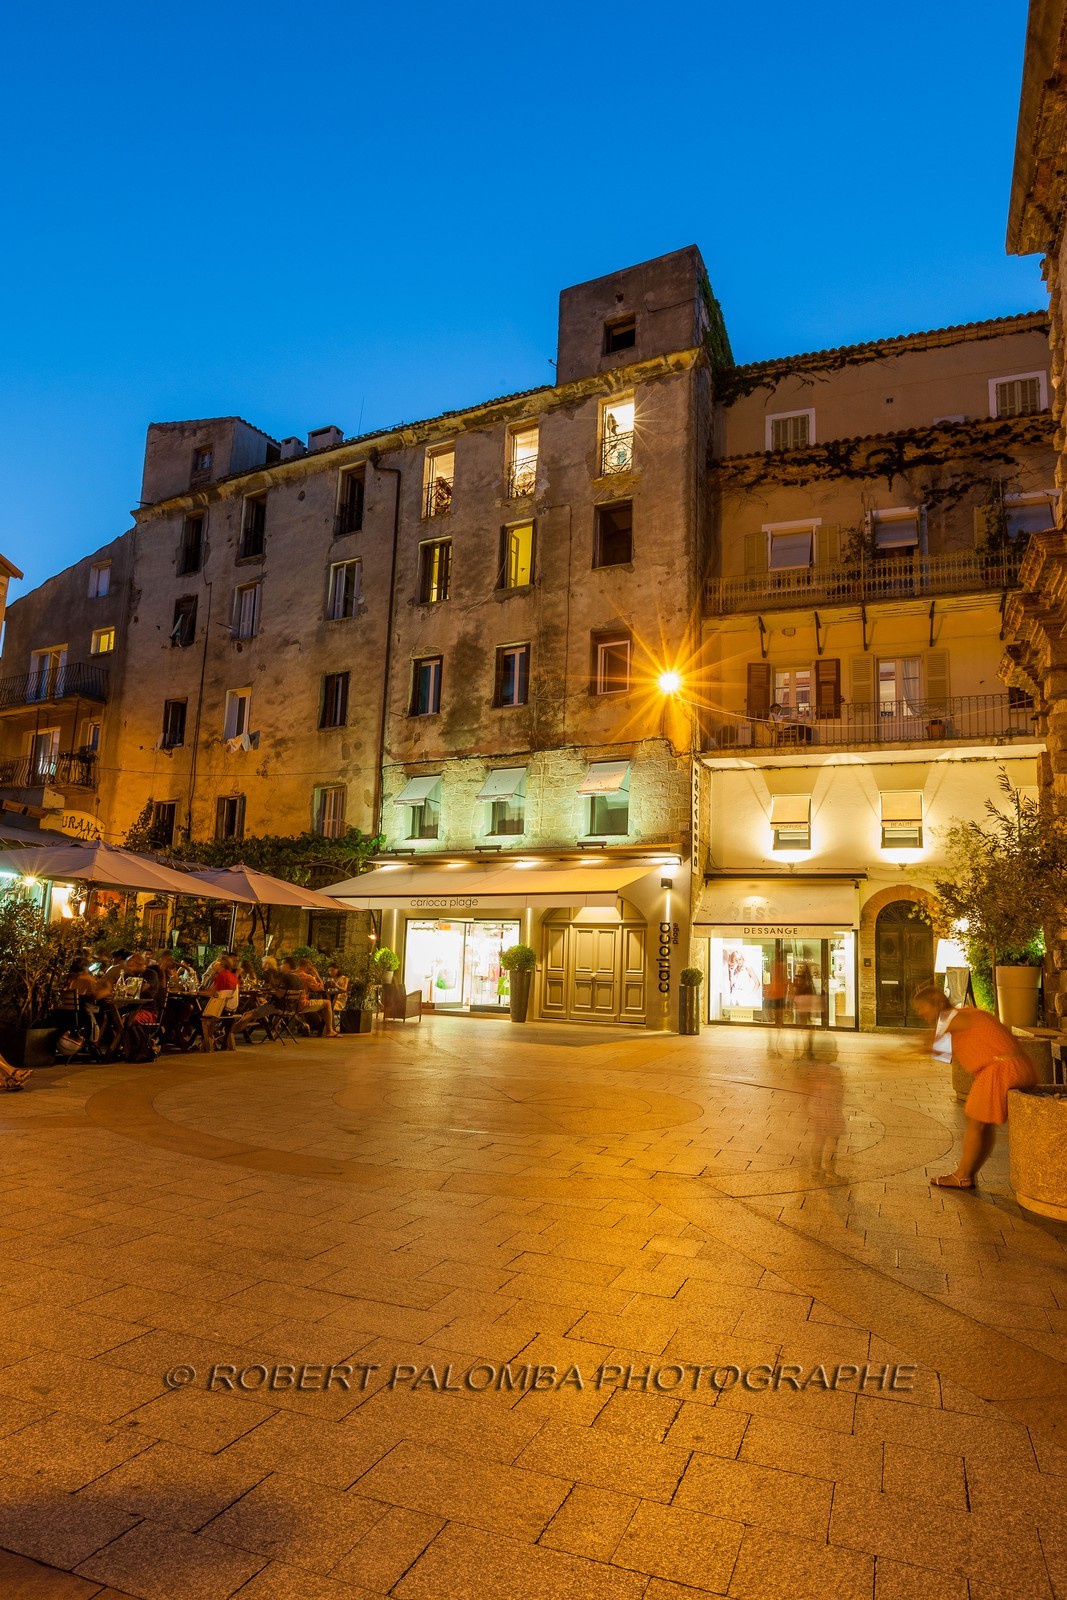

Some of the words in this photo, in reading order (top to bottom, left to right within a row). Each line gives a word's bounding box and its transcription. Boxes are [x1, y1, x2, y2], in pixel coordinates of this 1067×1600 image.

[410, 897, 447, 907] carioca
[449, 897, 479, 909] plage
[671, 922, 680, 945] plage
[743, 926, 799, 935] DESSANGE
[656, 922, 671, 993] carioca
